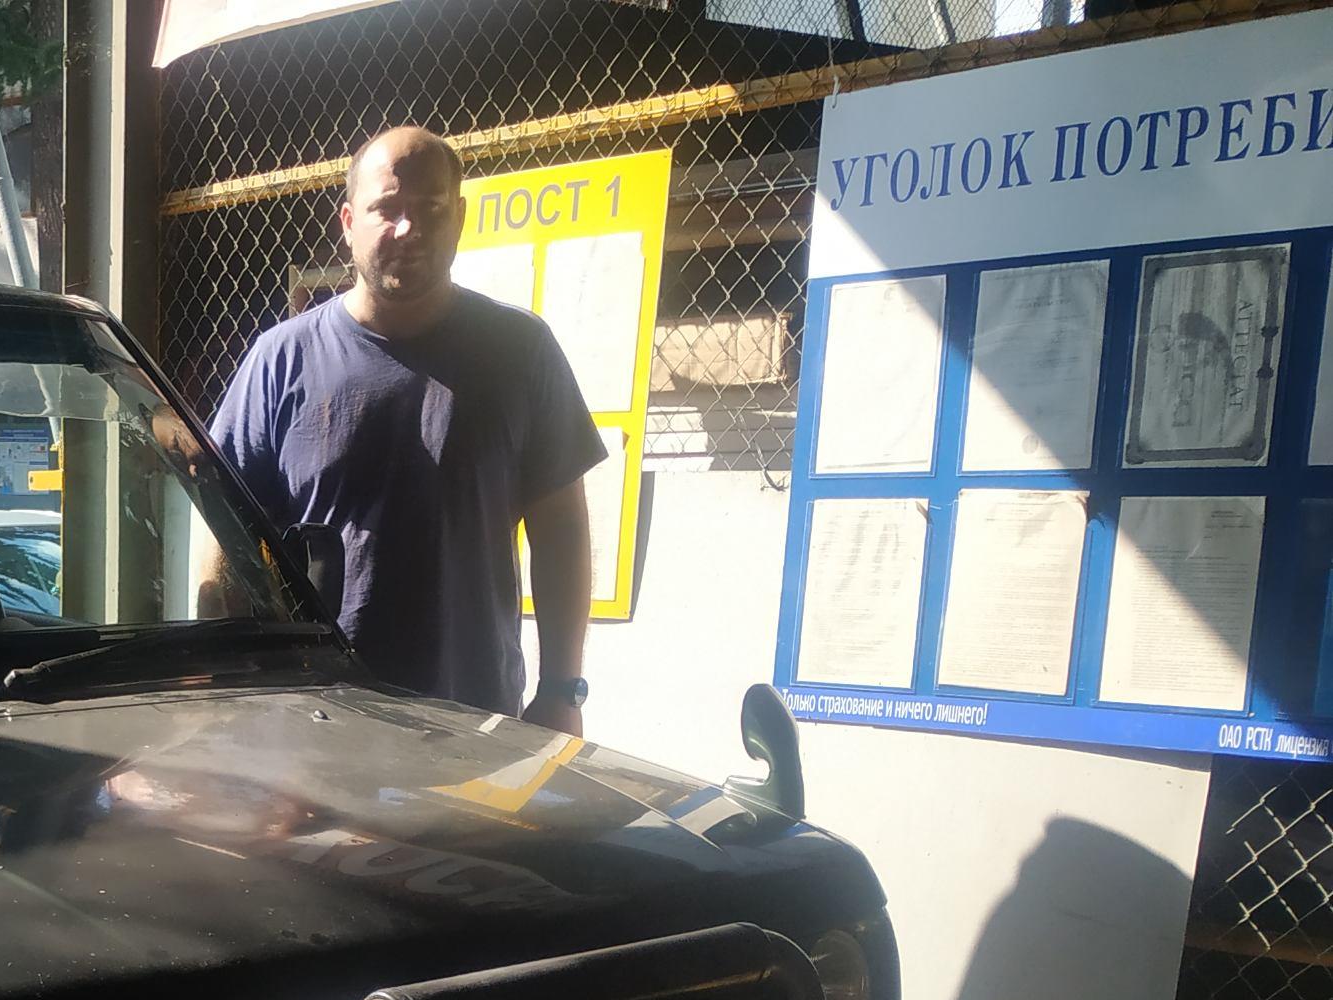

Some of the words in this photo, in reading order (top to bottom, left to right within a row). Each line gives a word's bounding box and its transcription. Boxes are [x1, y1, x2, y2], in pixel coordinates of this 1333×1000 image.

[830, 130, 1035, 211] УГОЛОК
[477, 180, 589, 234] ПОСТ
[605, 175, 621, 217] 1
[781, 688, 816, 714] Только
[817, 694, 883, 717] страхование
[885, 701, 893, 718] и
[894, 702, 933, 722] ничего
[933, 702, 988, 726] лишнего!
[1218, 724, 1243, 749] ОАО
[1245, 726, 1274, 751] РСТК
[1275, 734, 1329, 759] лицензия
